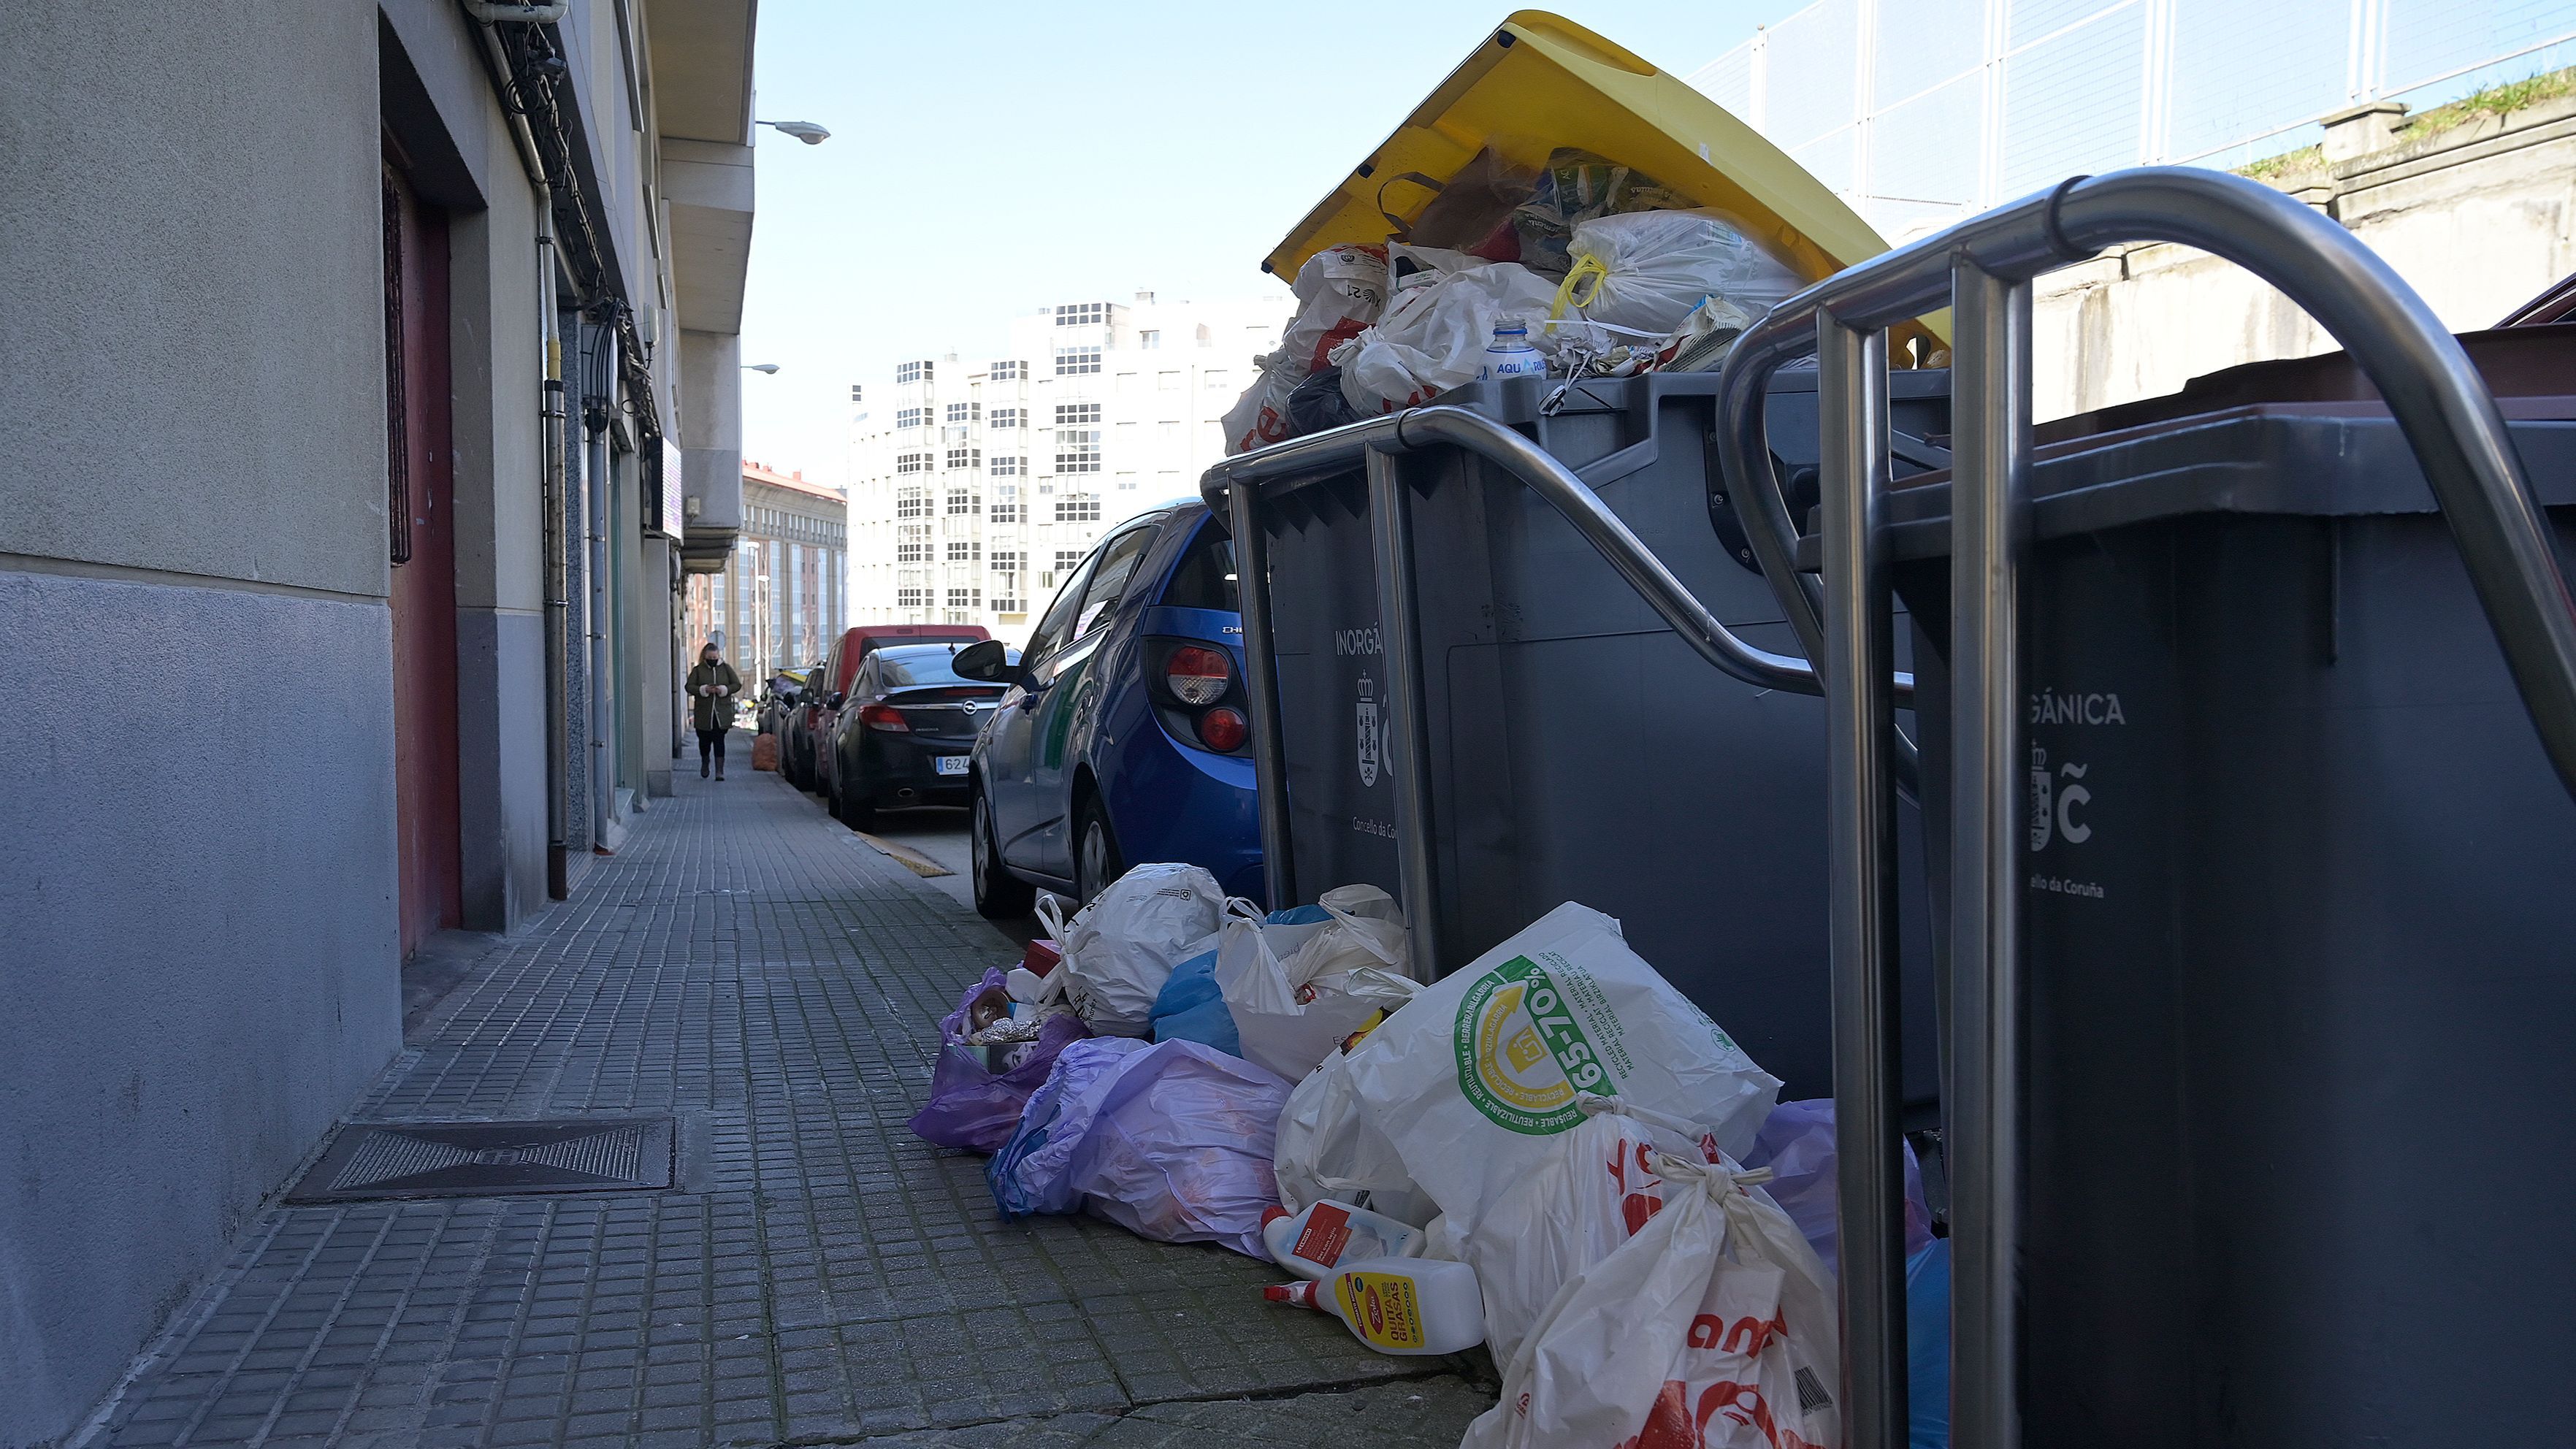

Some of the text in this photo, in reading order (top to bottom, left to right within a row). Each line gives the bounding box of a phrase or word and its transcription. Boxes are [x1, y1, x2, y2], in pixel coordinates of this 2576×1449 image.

[1377, 822, 1386, 836] da
[2063, 879, 2104, 898] Coruña
[1461, 979, 1495, 1044] BERRERABILGARRIA
[1538, 952, 1629, 1079] RECYCLED MATERIAL MATERIAL RECICLADO
[1548, 951, 1635, 1071] MATERIAL RECICLAT MATERIAU RECICLAT
[1578, 965, 1625, 1036] MATERIAL BIRZIKLATUA
[1524, 967, 1602, 1088] 65-70%
[1484, 1063, 1564, 1102] RECYCLABLE RECICLABLE
[1484, 1099, 1534, 1127] REUTILIZABLE
[1540, 1109, 1578, 1127] REUSABLE
[1354, 1302, 1363, 1327] FORMATO
[1384, 1299, 1400, 1341] QUITA
[1390, 1282, 1408, 1342] GRASAS
